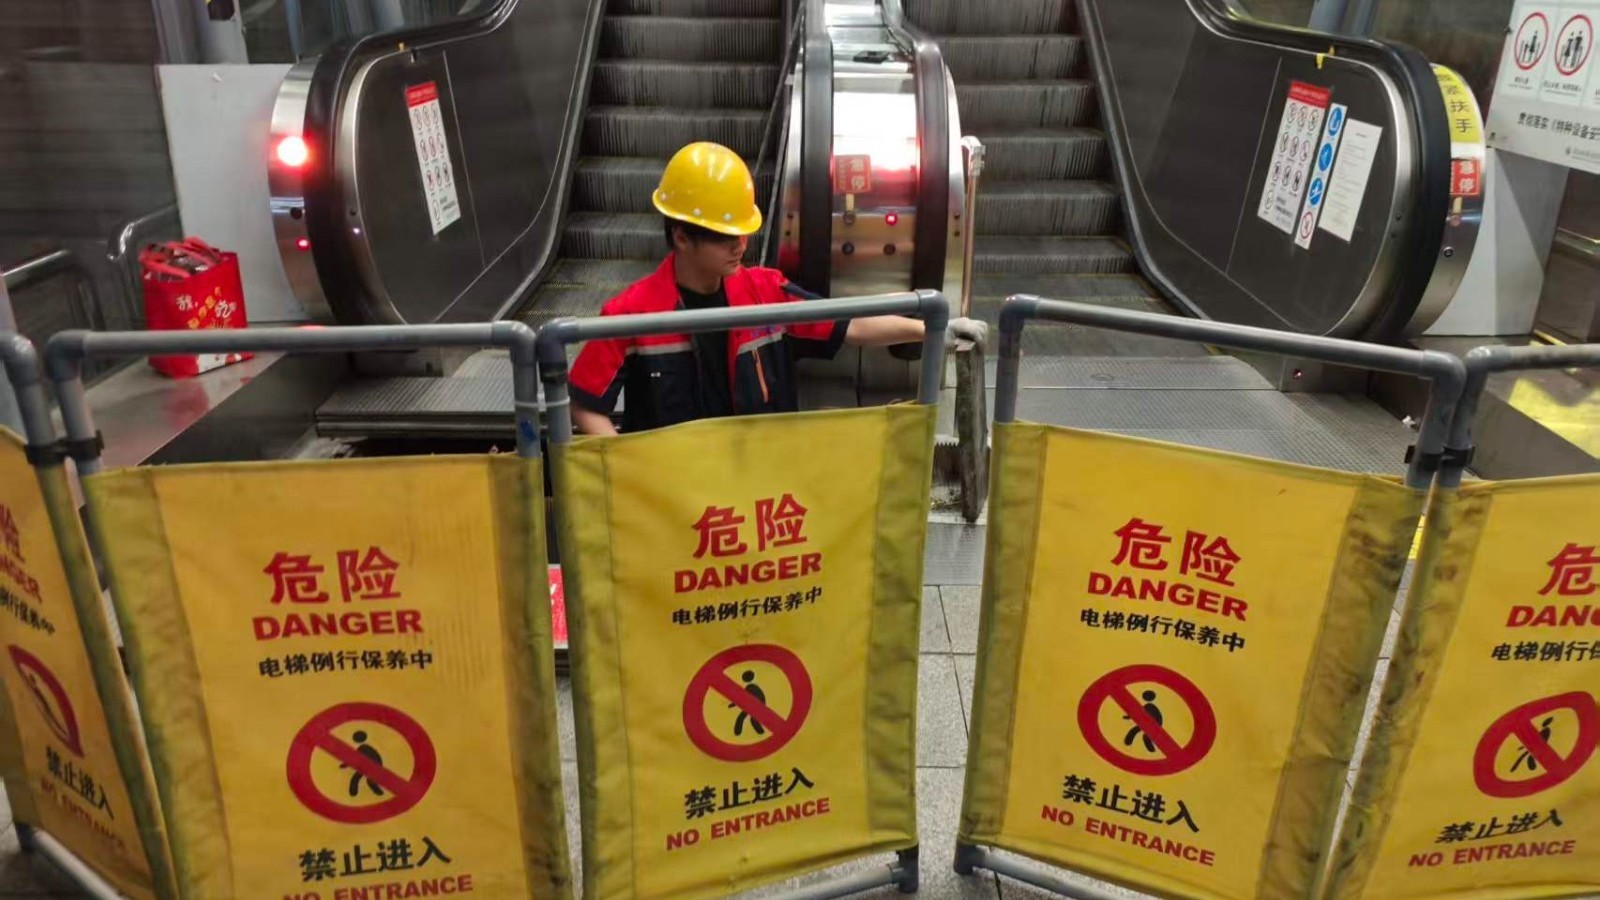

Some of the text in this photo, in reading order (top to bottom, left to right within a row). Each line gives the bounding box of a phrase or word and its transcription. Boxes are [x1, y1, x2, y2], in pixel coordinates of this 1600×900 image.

[694, 493, 808, 559] 危险
[263, 546, 402, 604] 危险
[674, 552, 822, 594] DANGER
[1111, 517, 1242, 587] 危险
[671, 586, 822, 626] 电梯例行保养中
[1087, 571, 1249, 621] DANGER
[252, 609, 424, 641] DANGER
[1080, 608, 1246, 653] 电梯例行保养中
[259, 649, 433, 678] 电梯例行保养中
[46, 745, 115, 821] 禁止进入
[684, 766, 814, 820] 禁止进入
[1062, 774, 1201, 833] 禁止进入
[666, 797, 830, 850] NO ENTRANCE
[1041, 805, 1216, 866] NO ENTRANCE
[1435, 808, 1564, 844] 禁止进入
[299, 836, 452, 882] 禁止进入
[1408, 840, 1576, 867] NO ENTRANCE
[334, 874, 473, 900] ENTRANCE
